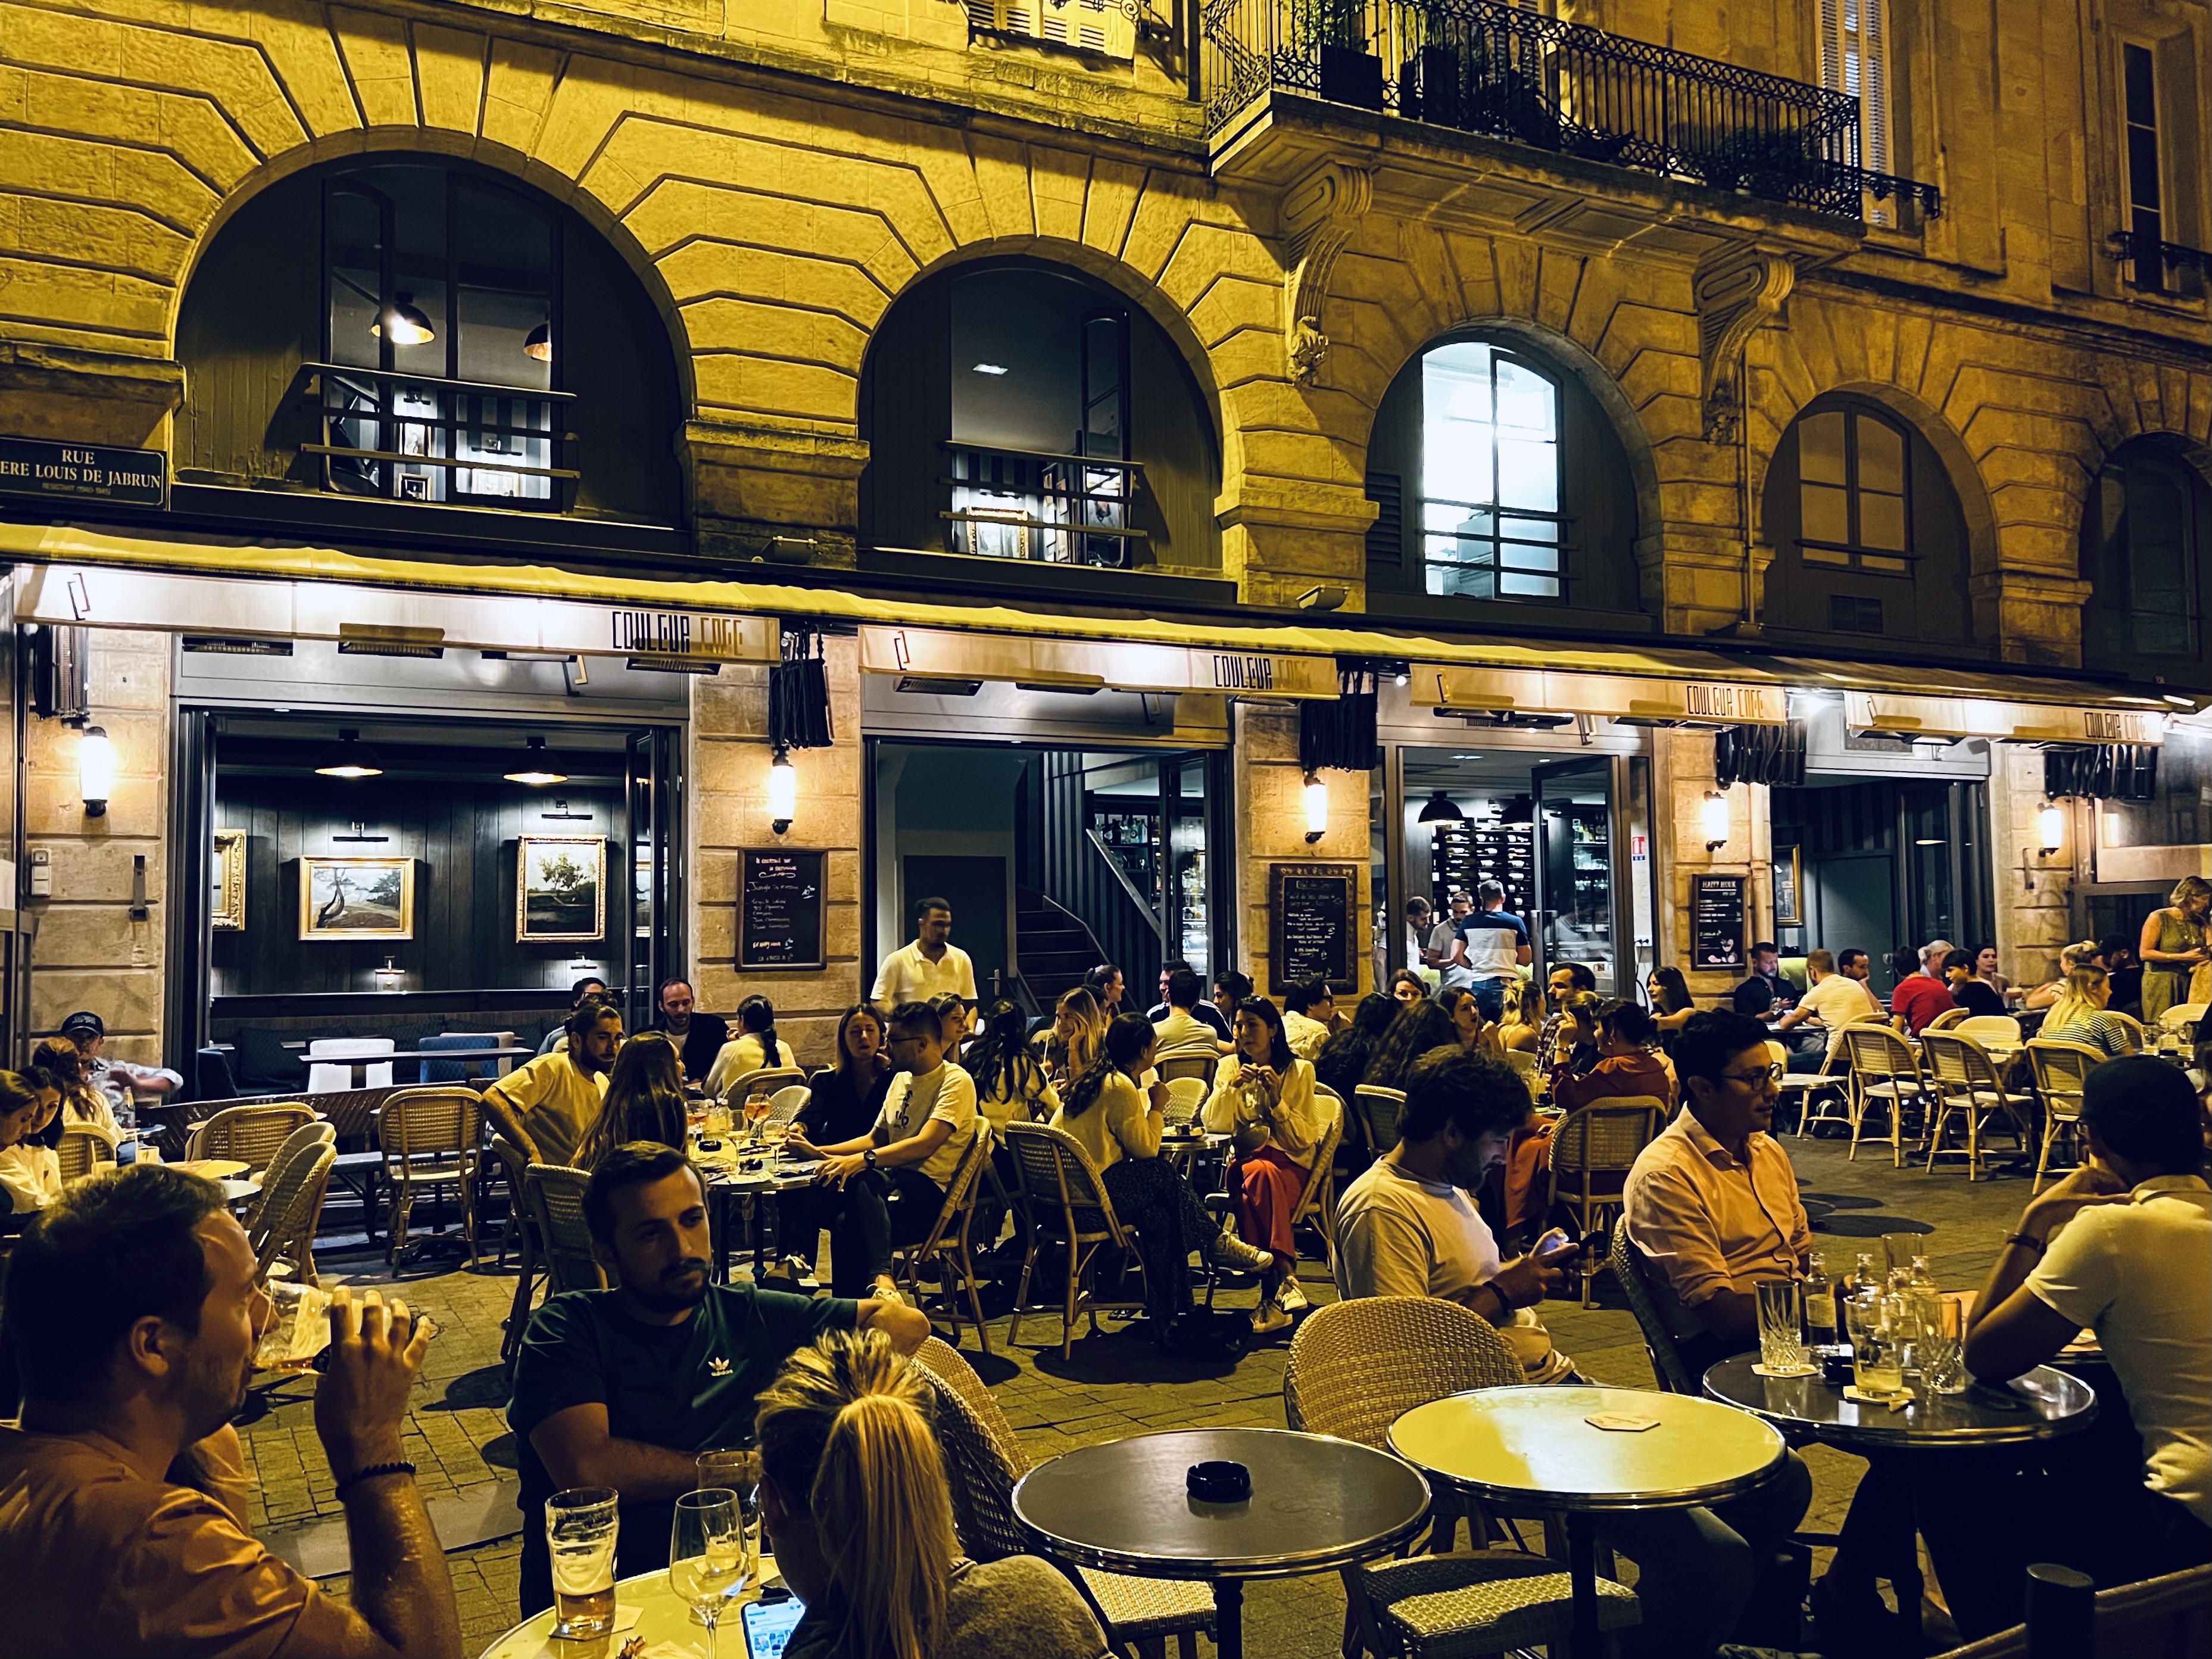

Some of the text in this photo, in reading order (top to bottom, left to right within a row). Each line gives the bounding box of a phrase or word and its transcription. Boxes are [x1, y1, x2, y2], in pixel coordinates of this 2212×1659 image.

[62, 449, 95, 464] RUE
[35, 464, 77, 481] LOUIS
[83, 469, 102, 483] DE
[107, 471, 161, 488] JABRUN
[612, 611, 690, 653] COULEUR
[1213, 654, 1272, 690] COULEUR
[1686, 685, 1732, 716] COULEUR
